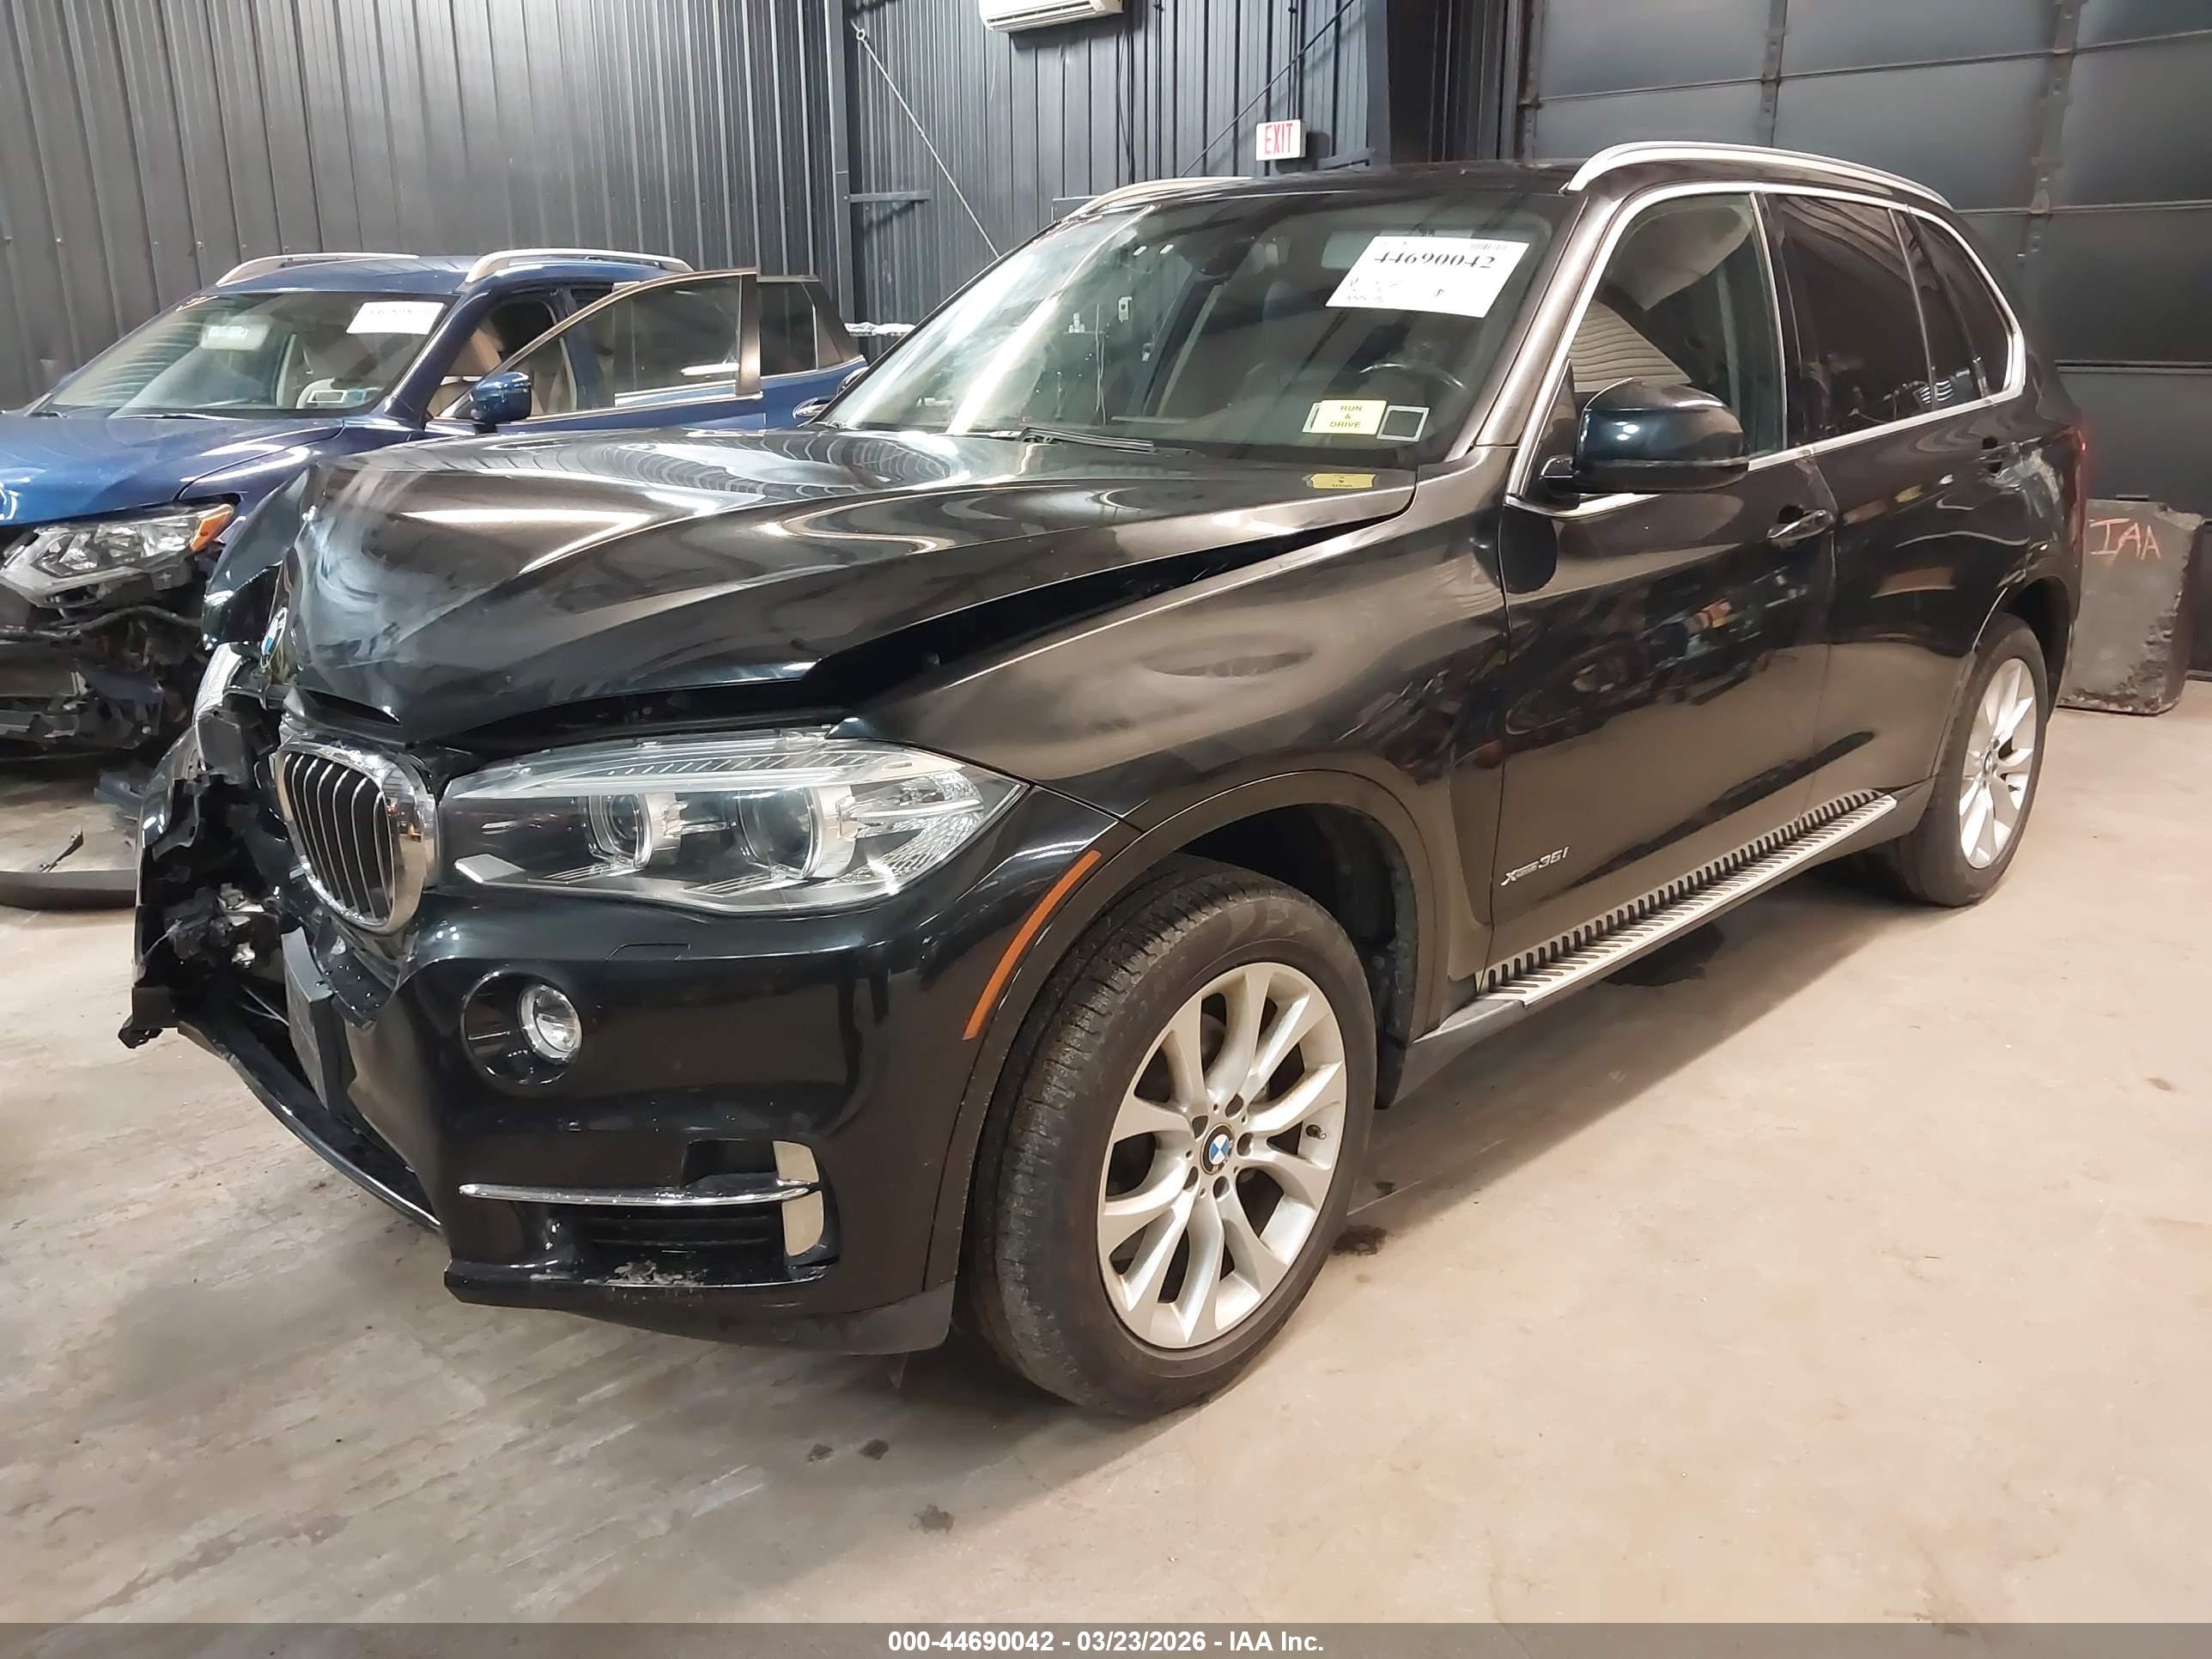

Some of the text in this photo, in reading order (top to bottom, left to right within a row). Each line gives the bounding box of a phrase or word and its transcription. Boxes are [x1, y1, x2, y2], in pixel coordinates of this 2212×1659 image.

[1265, 123, 1293, 155] EXIT
[1373, 251, 1497, 270] 44690042
[2087, 517, 2162, 562] IAA
